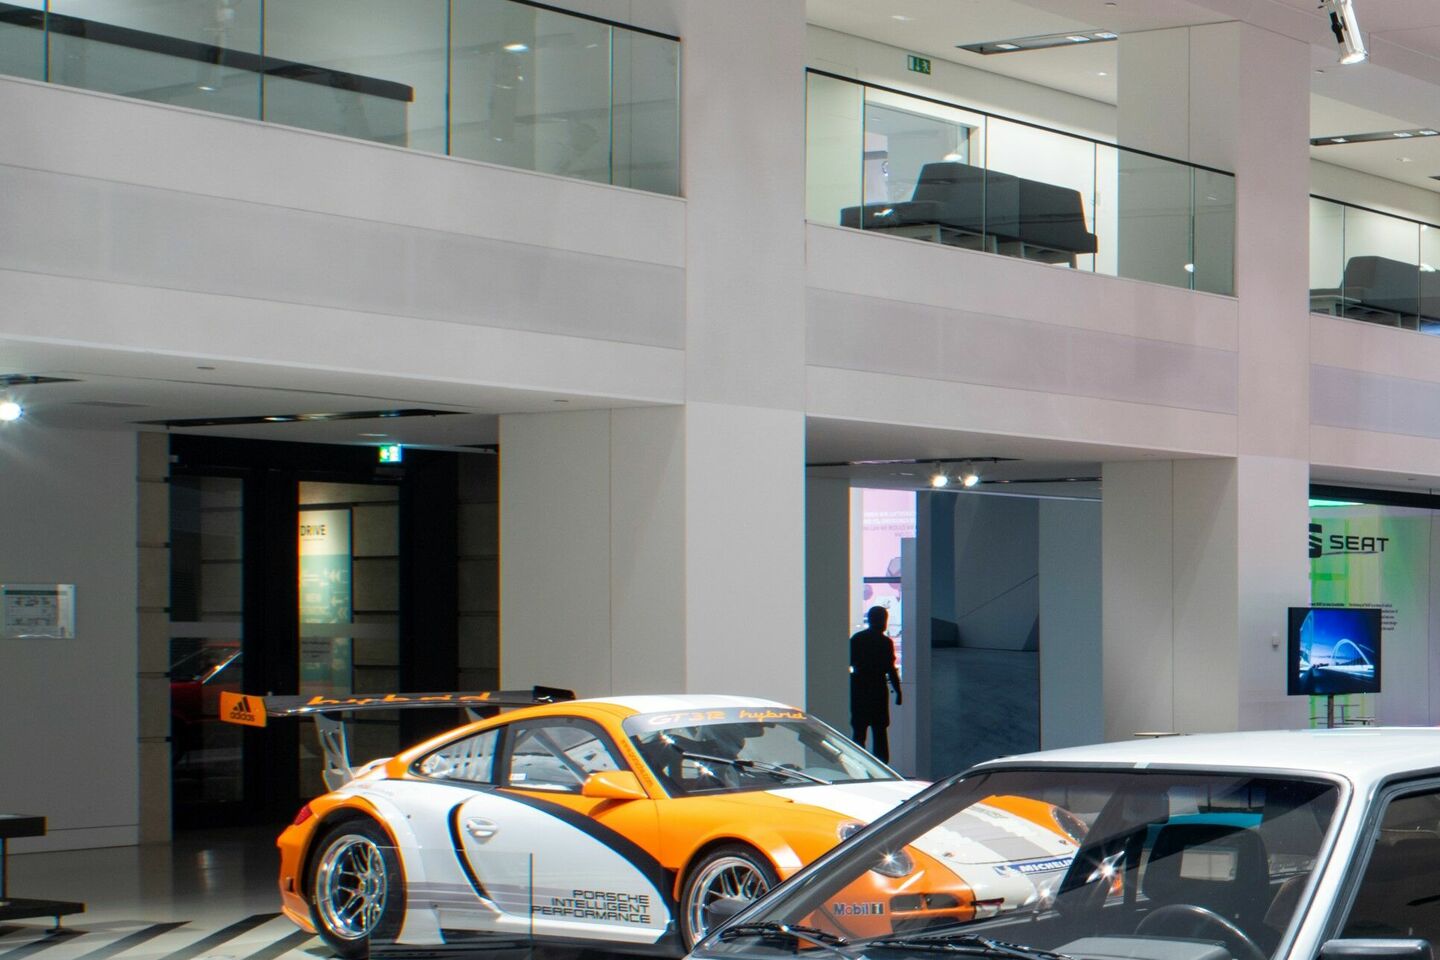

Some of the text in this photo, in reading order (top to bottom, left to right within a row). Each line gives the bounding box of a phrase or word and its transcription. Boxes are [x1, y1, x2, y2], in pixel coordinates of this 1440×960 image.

[300, 524, 327, 536] DRIVE
[1329, 534, 1390, 552] SEAT
[229, 711, 255, 722] adidas
[738, 710, 807, 722] hybrid
[572, 889, 649, 905] PORSCHE
[551, 897, 650, 914] INTELLIGENT
[834, 903, 869, 915] Mobil
[531, 905, 652, 924] PERFORMANCE
